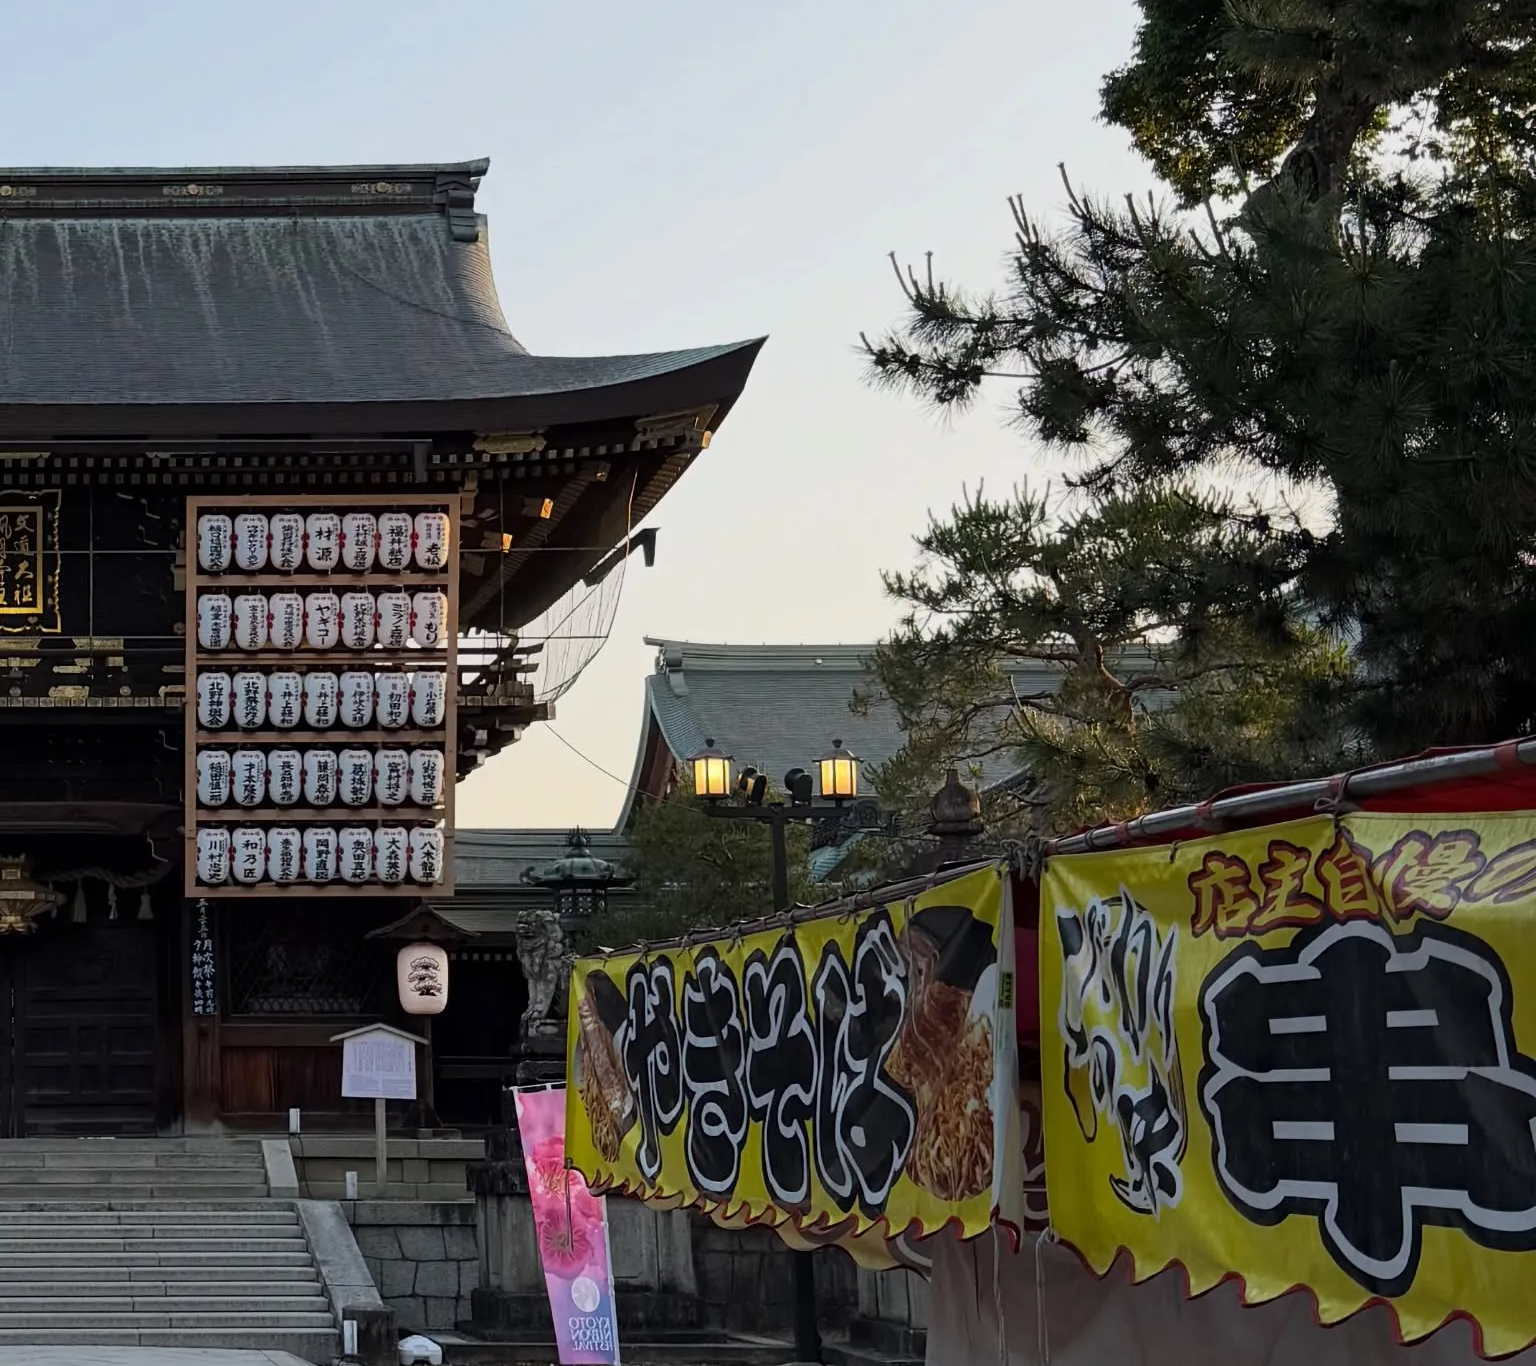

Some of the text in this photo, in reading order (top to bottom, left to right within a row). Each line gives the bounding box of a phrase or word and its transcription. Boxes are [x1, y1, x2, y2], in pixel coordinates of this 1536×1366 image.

[316, 527, 333, 562] 材源
[425, 543, 441, 566] 老松
[316, 605, 332, 645] ヤギコー
[425, 621, 438, 645] もり
[243, 840, 259, 879] 和乃匠
[623, 905, 915, 1221] やきそば
